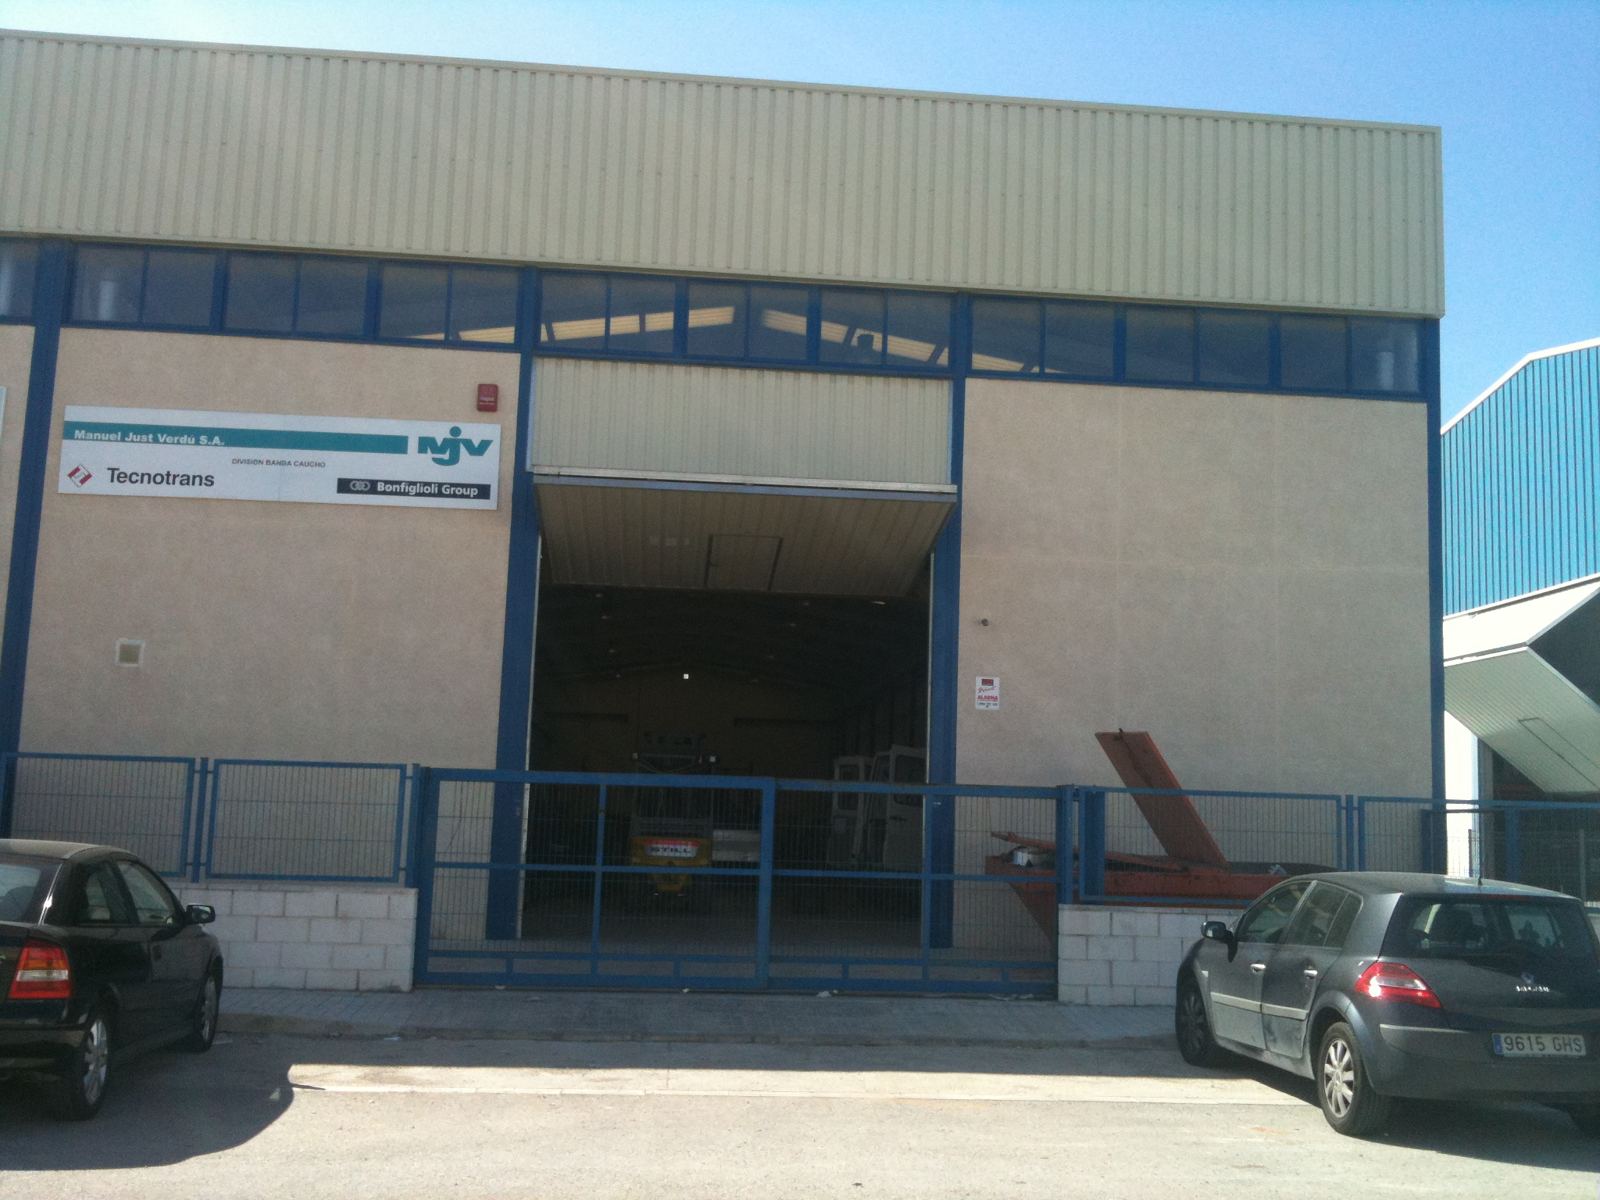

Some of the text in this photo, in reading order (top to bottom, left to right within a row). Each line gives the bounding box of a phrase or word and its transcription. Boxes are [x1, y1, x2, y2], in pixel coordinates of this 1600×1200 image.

[74, 429, 121, 441] Manuel
[125, 432, 154, 443] Just
[199, 435, 225, 446] S.A.
[293, 460, 326, 468] CAUCHO
[107, 467, 215, 487] Tecnotrans
[377, 481, 479, 498] Bonfiglioli Group
[1503, 1035, 1583, 1053] 9615 GHS
